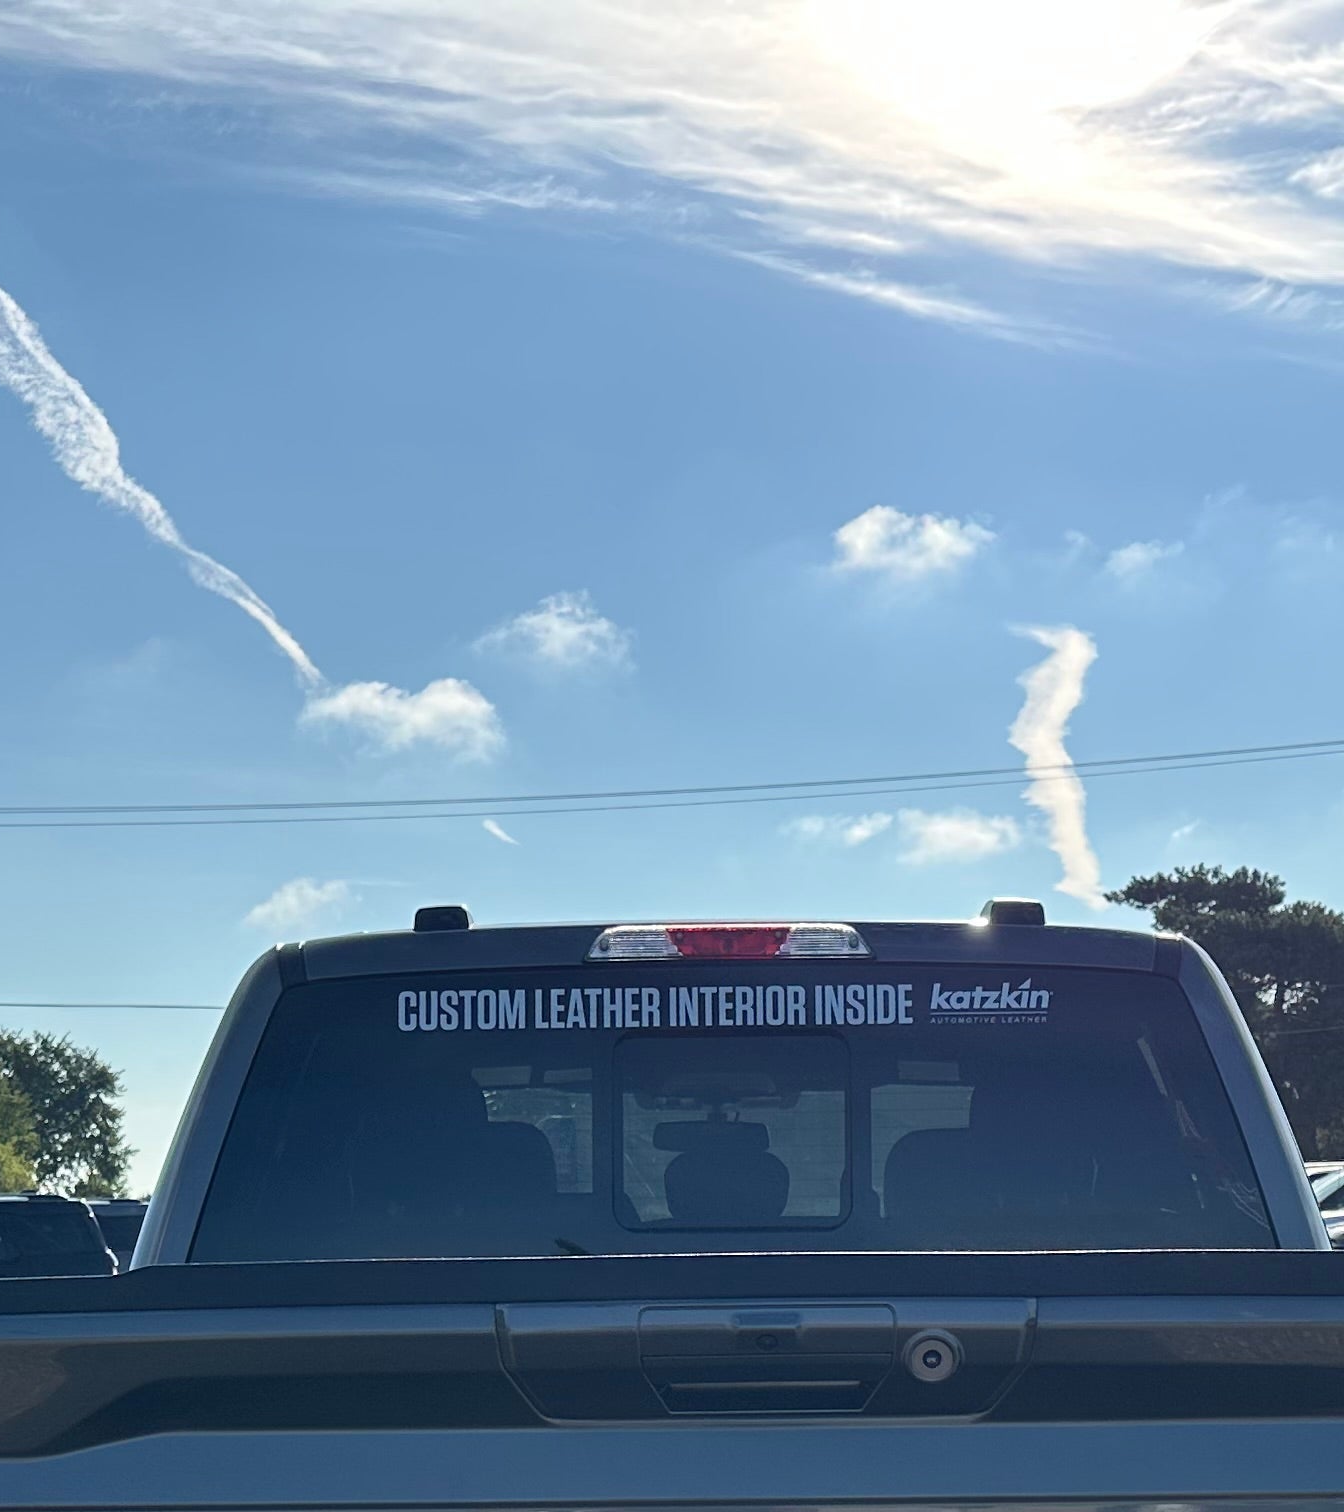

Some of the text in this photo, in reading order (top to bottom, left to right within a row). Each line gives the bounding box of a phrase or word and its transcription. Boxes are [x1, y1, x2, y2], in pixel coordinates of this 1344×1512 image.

[397, 984, 913, 1031] CUSTOM LEATHER INTERIOR INSIDE
[930, 977, 1050, 1010] katzkin
[930, 1015, 1047, 1024] AUTOMOTIVE LEATHER
